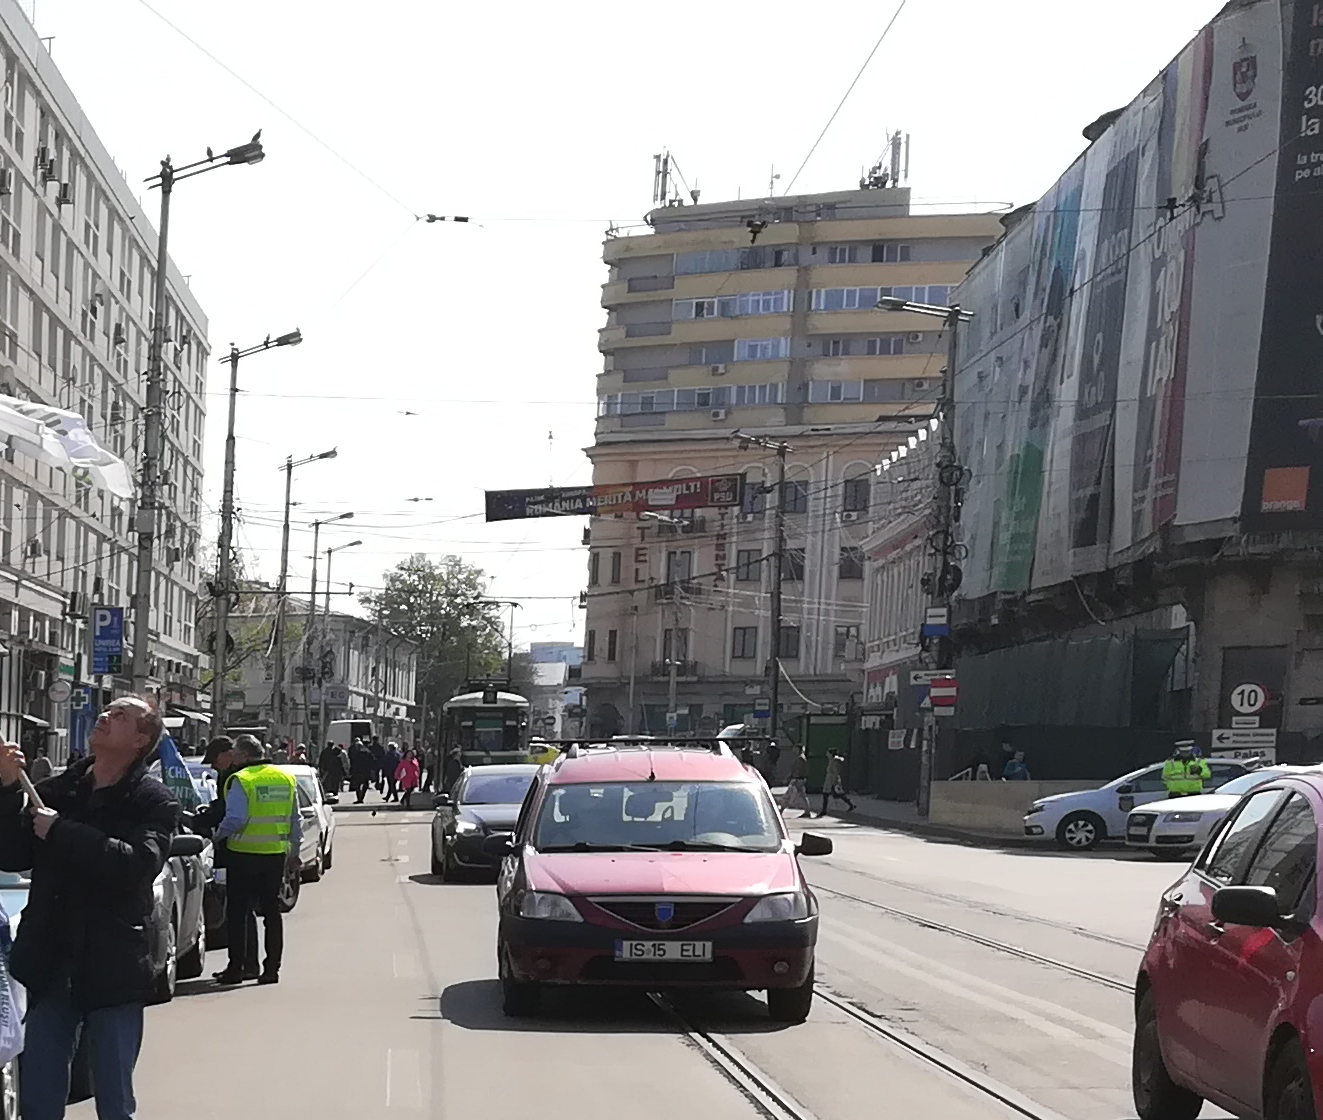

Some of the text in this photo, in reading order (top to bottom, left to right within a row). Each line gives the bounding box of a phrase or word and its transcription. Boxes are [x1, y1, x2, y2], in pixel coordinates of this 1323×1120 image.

[96, 610, 112, 636] P
[1237, 689, 1258, 707] 10
[1234, 749, 1267, 759] Palas
[629, 943, 706, 958] IS 15 ELI
